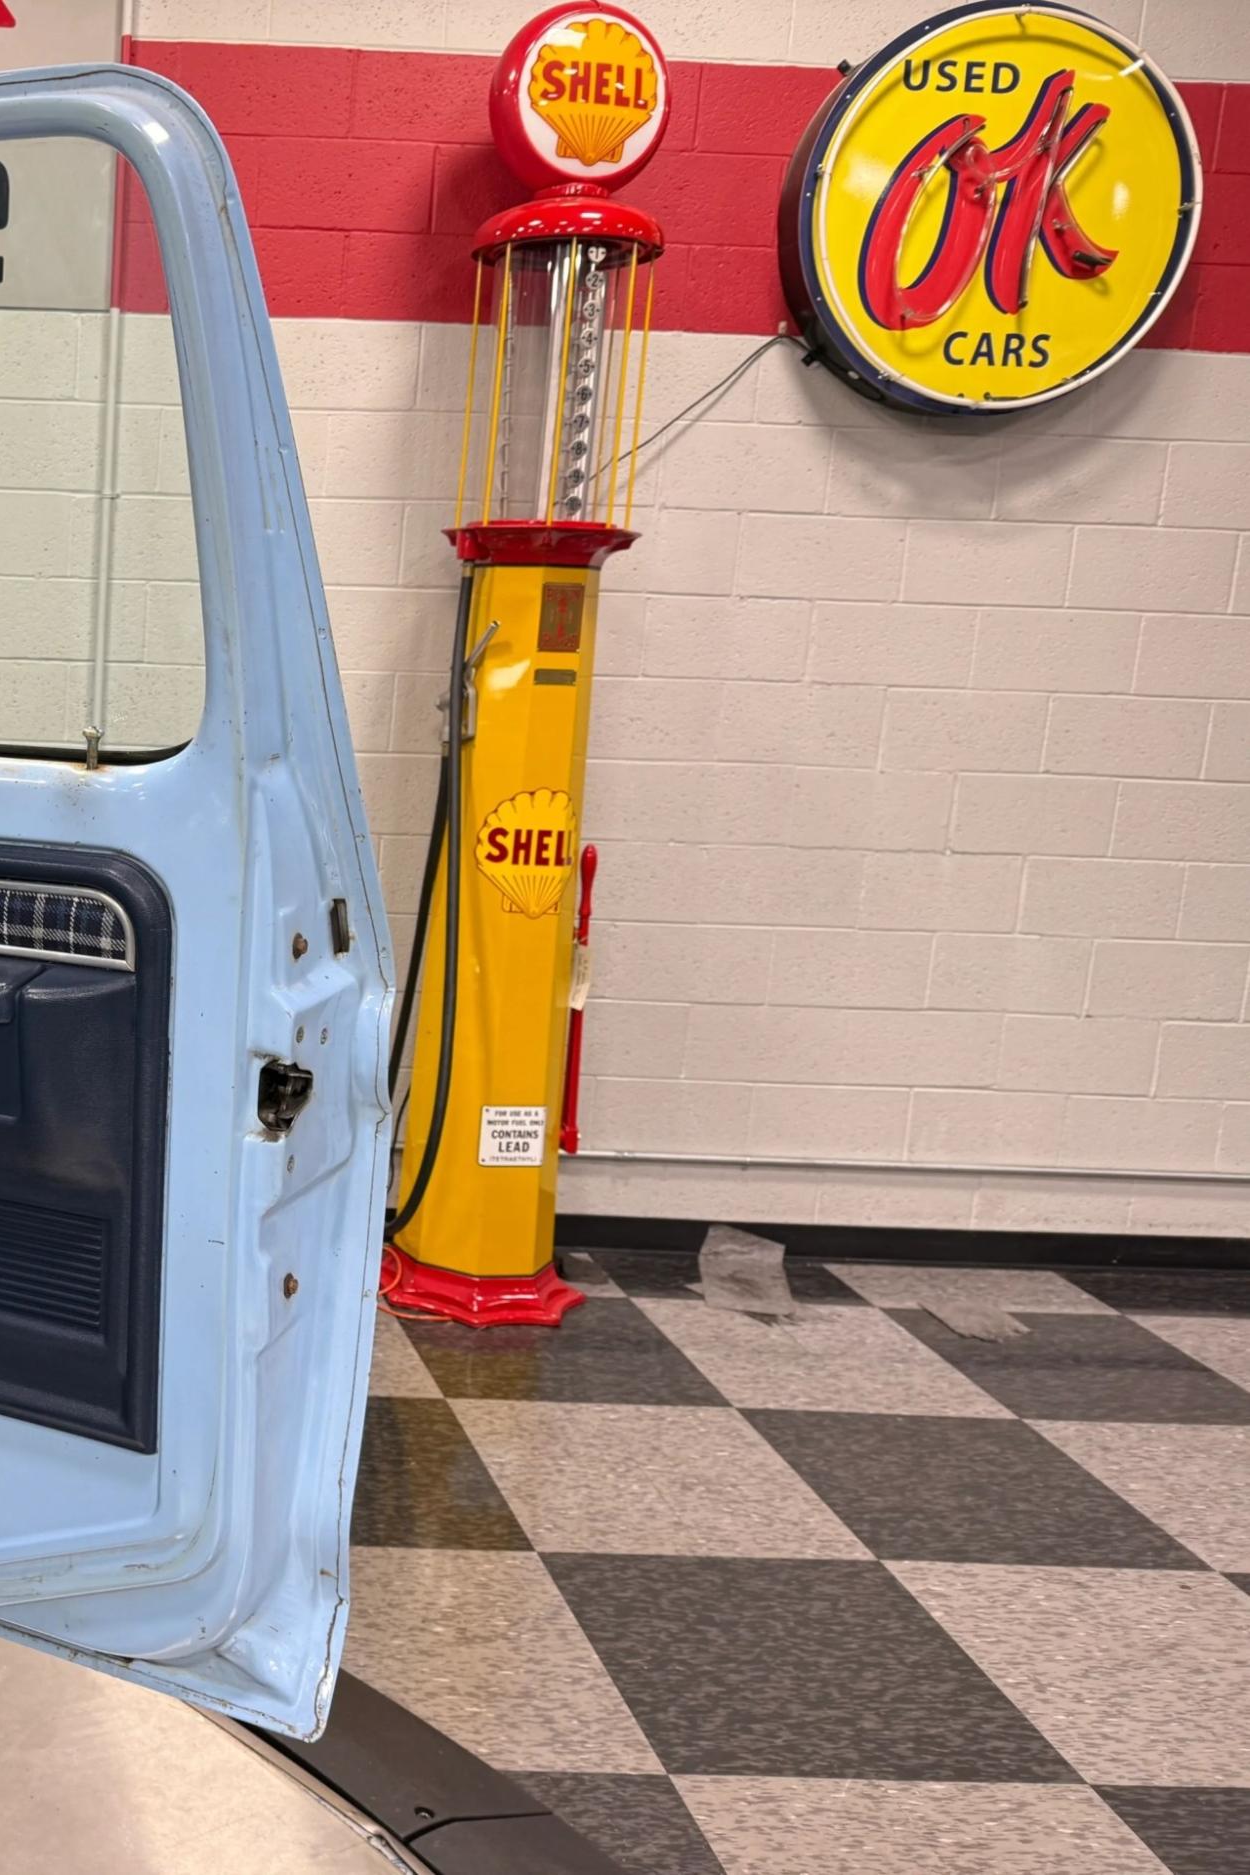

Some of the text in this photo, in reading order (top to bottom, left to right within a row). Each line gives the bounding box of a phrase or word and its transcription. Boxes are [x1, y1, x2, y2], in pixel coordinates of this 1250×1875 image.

[541, 59, 651, 111] SHELL
[901, 59, 1022, 95] USED
[858, 68, 1121, 333] OK
[942, 331, 1051, 369] CARS
[491, 1129, 539, 1140] CONTAINS
[498, 1141, 530, 1153] LEAD
